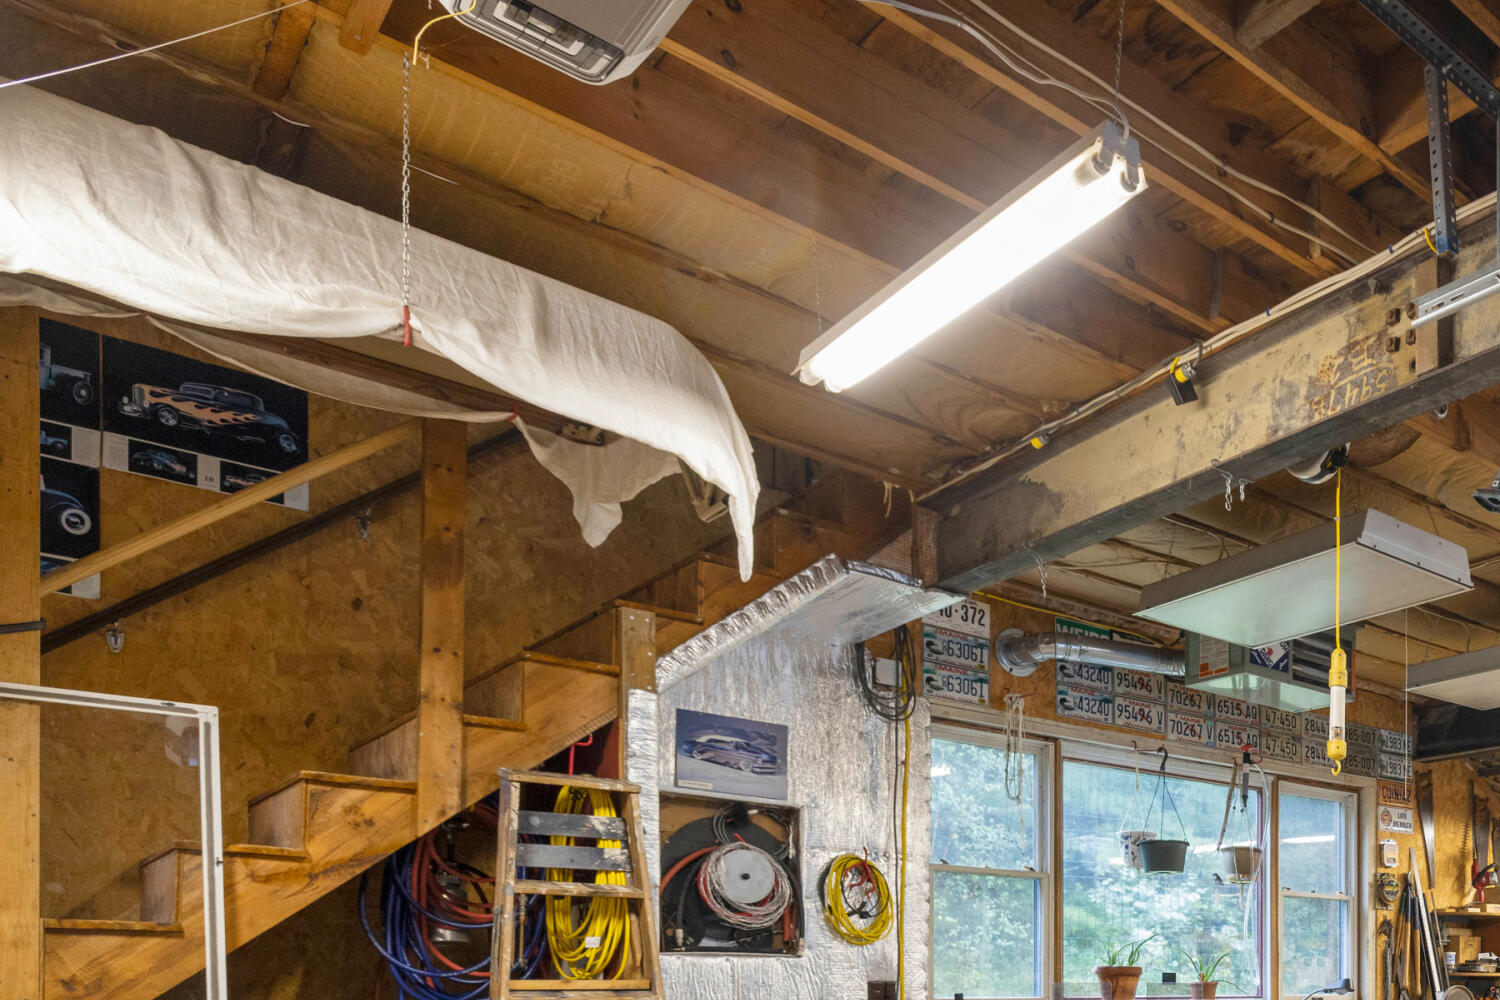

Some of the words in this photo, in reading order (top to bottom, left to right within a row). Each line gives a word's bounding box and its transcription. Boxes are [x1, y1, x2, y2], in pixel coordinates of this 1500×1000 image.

[938, 664, 968, 676] MAINE
[1116, 672, 1152, 693] 95496
[1169, 688, 1202, 709] 70267
[1217, 699, 1243, 717] 6515
[1117, 703, 1152, 724] 95496
[1157, 710, 1163, 725] V
[1169, 719, 1203, 739] 70267
[1218, 728, 1243, 746] 6515
